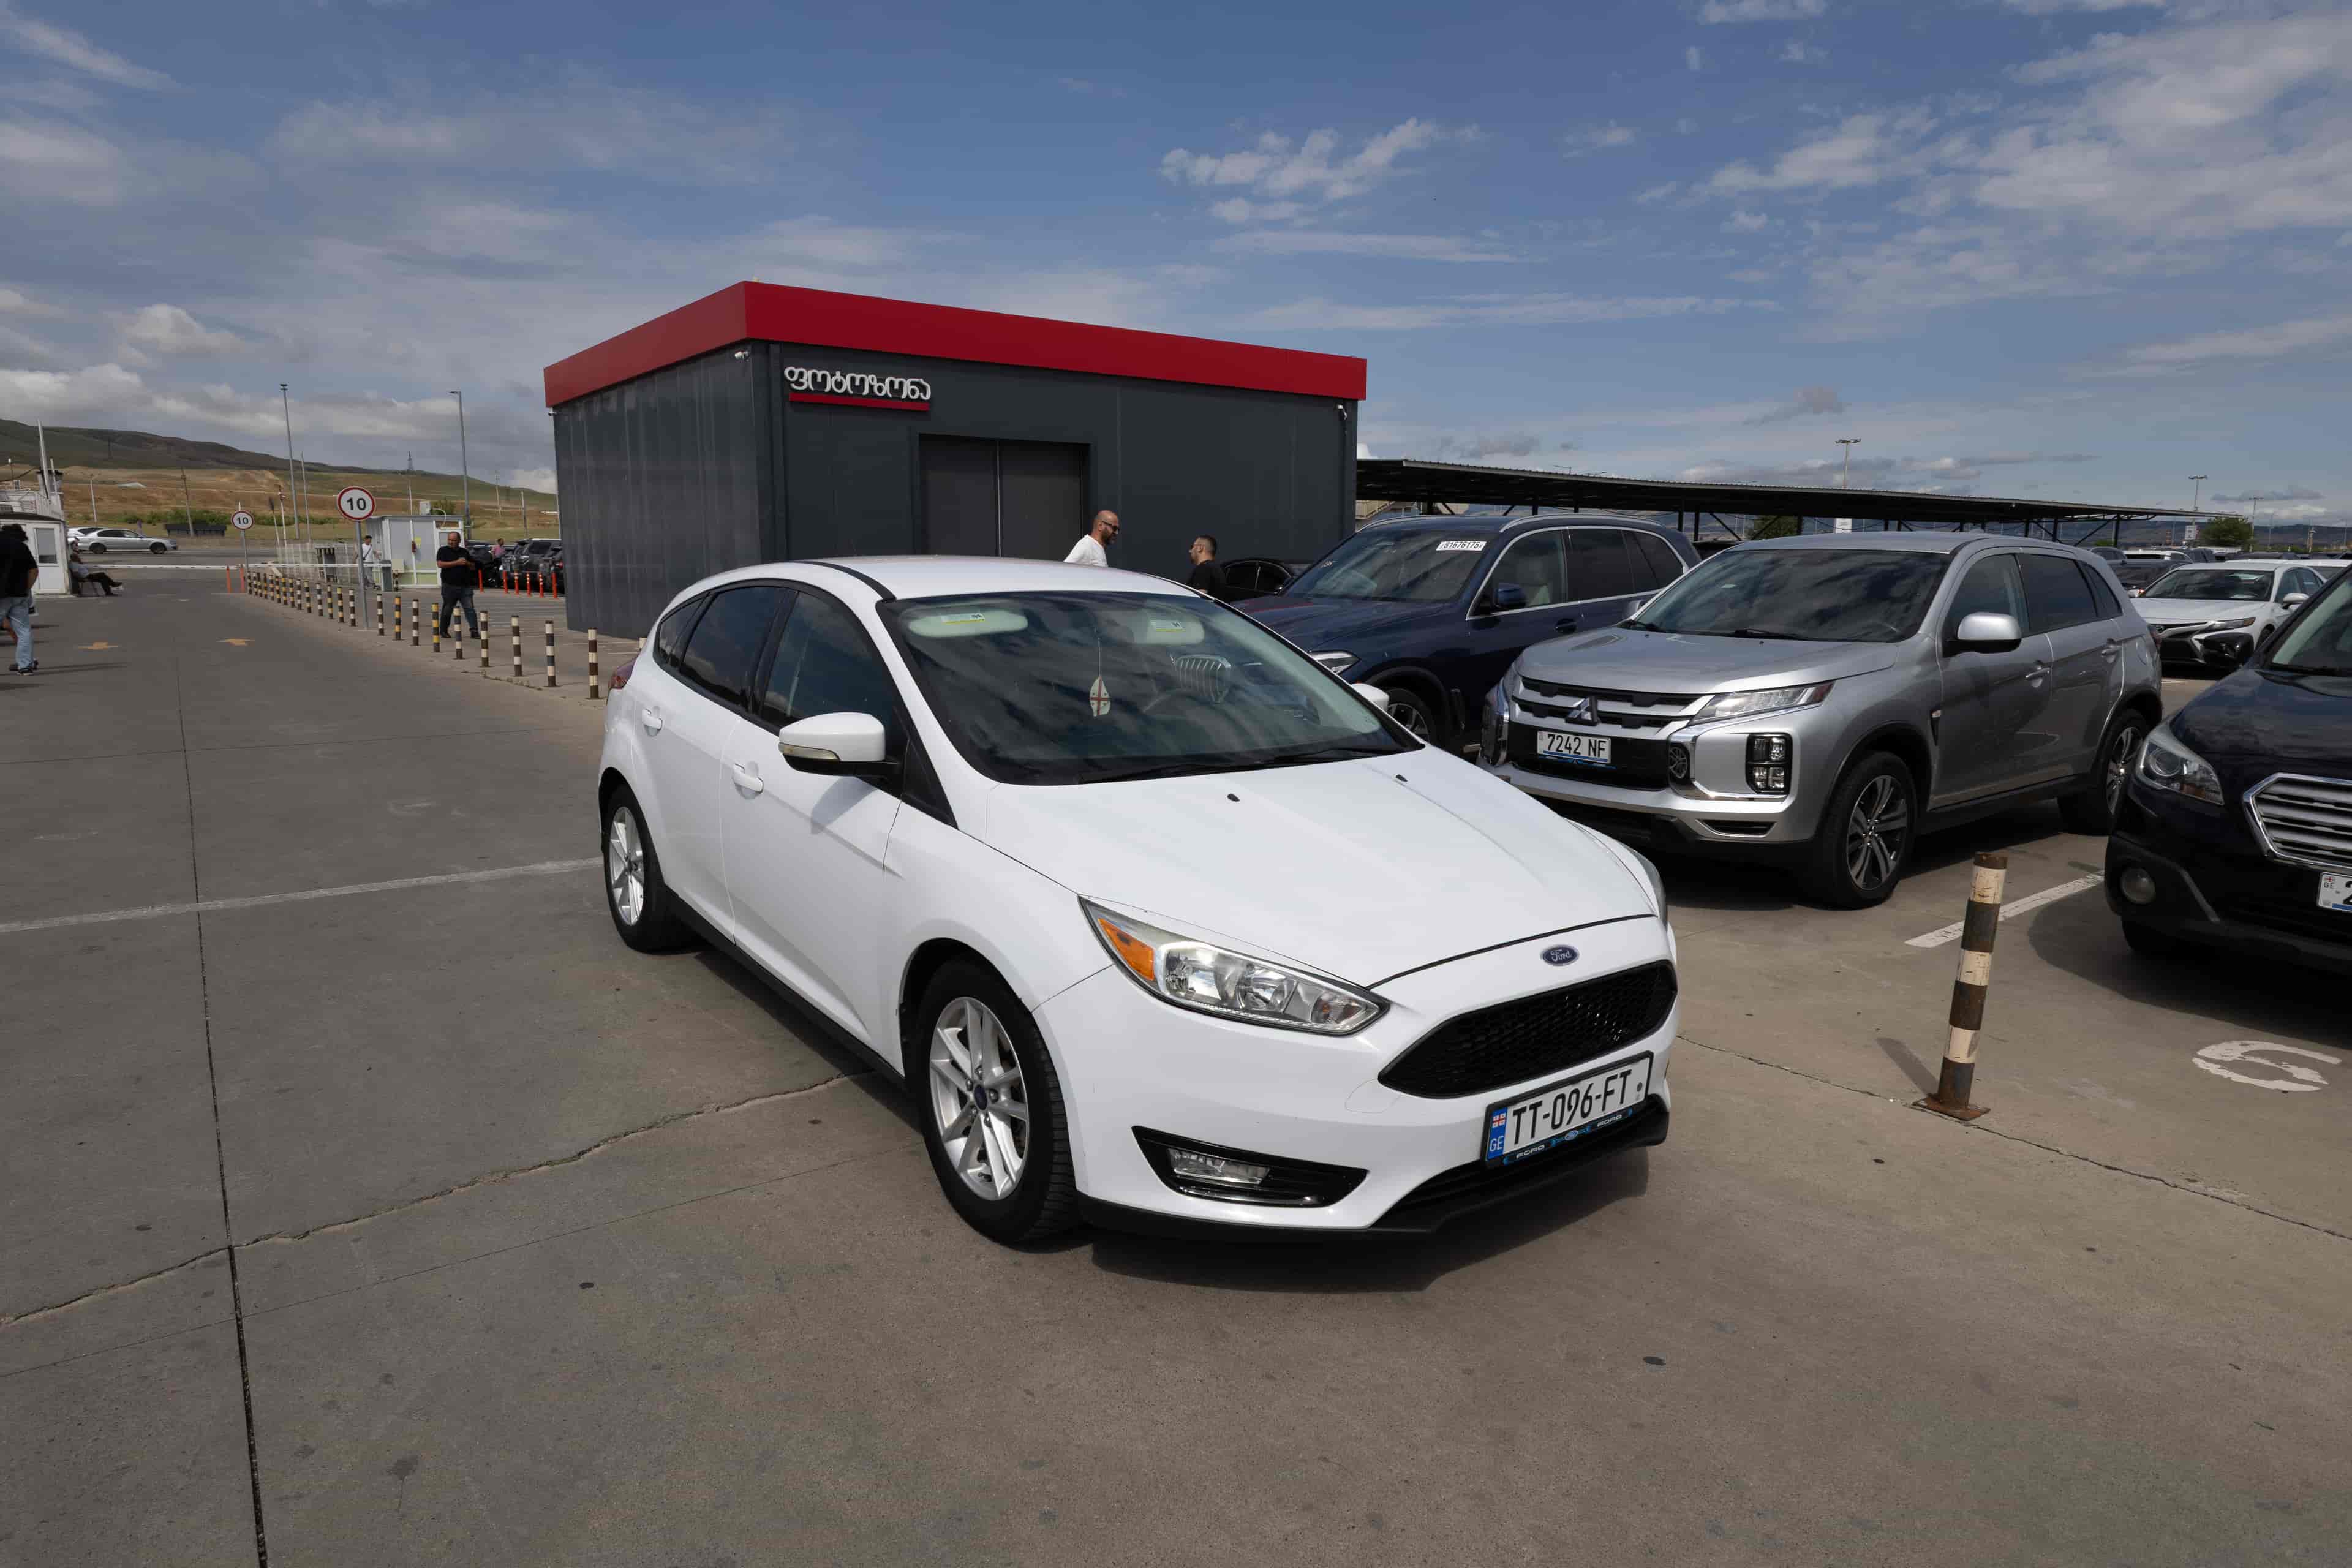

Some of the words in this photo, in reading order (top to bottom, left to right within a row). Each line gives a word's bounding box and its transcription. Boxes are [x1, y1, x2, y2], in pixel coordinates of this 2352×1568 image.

[784, 367, 931, 400] ფოტოზონა
[347, 497, 366, 510] 10
[236, 516, 249, 525] 10
[1548, 734, 1581, 755] 7242
[1588, 739, 1607, 758] NF
[1550, 949, 1572, 962] Ford
[1512, 1069, 1632, 1145] TT-096-FT
[1490, 1136, 1504, 1152] GE
[1516, 1144, 1545, 1159] FORD
[1597, 1114, 1623, 1128] FORD
